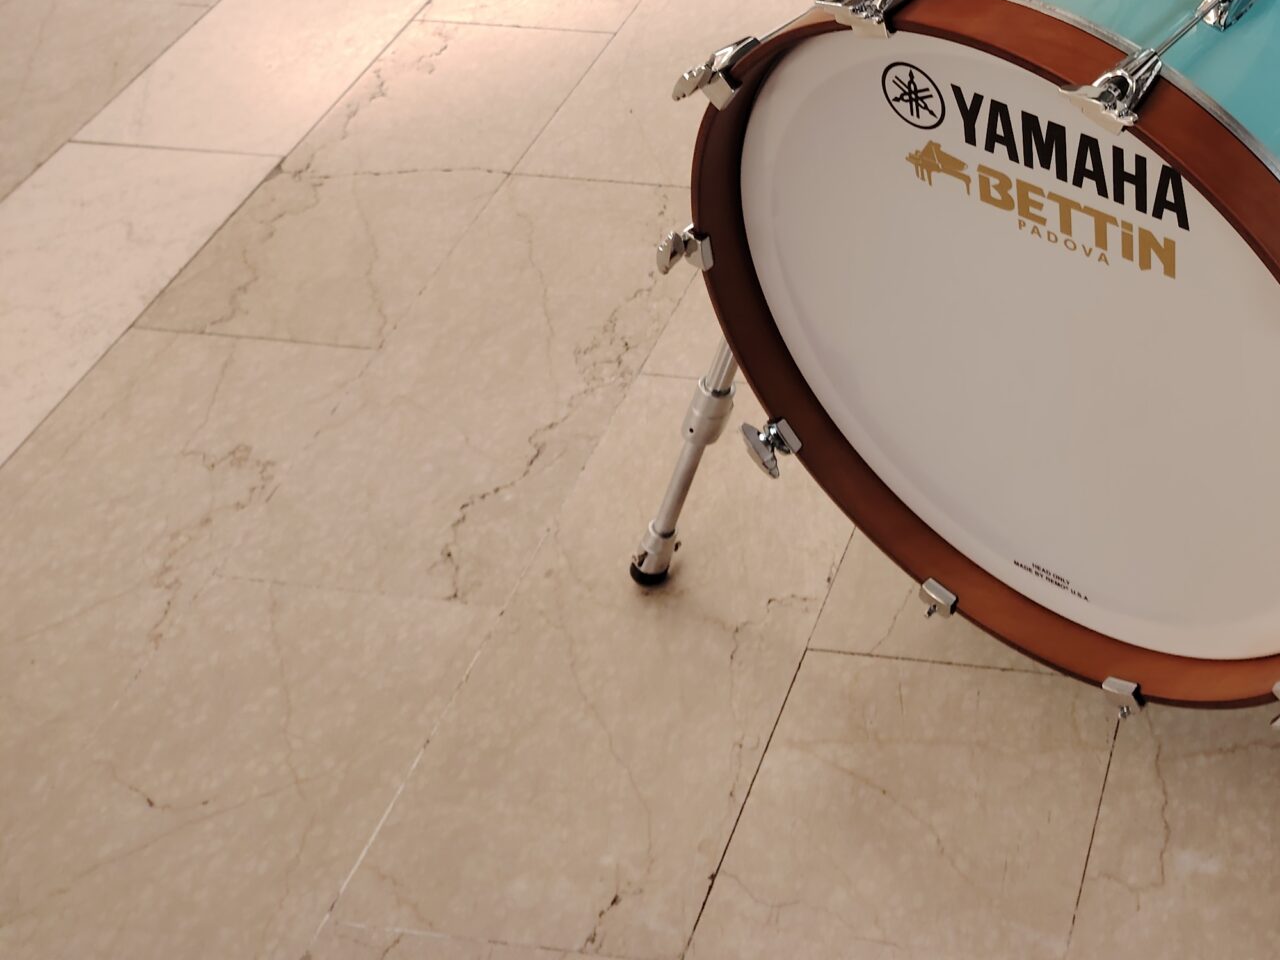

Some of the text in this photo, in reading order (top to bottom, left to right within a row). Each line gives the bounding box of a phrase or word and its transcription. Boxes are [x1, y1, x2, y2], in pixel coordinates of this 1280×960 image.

[951, 83, 1190, 231] YAMAHA
[1018, 219, 1110, 266] PADOVA
[1013, 559, 1033, 573] MADE
[1034, 570, 1044, 579] BY
